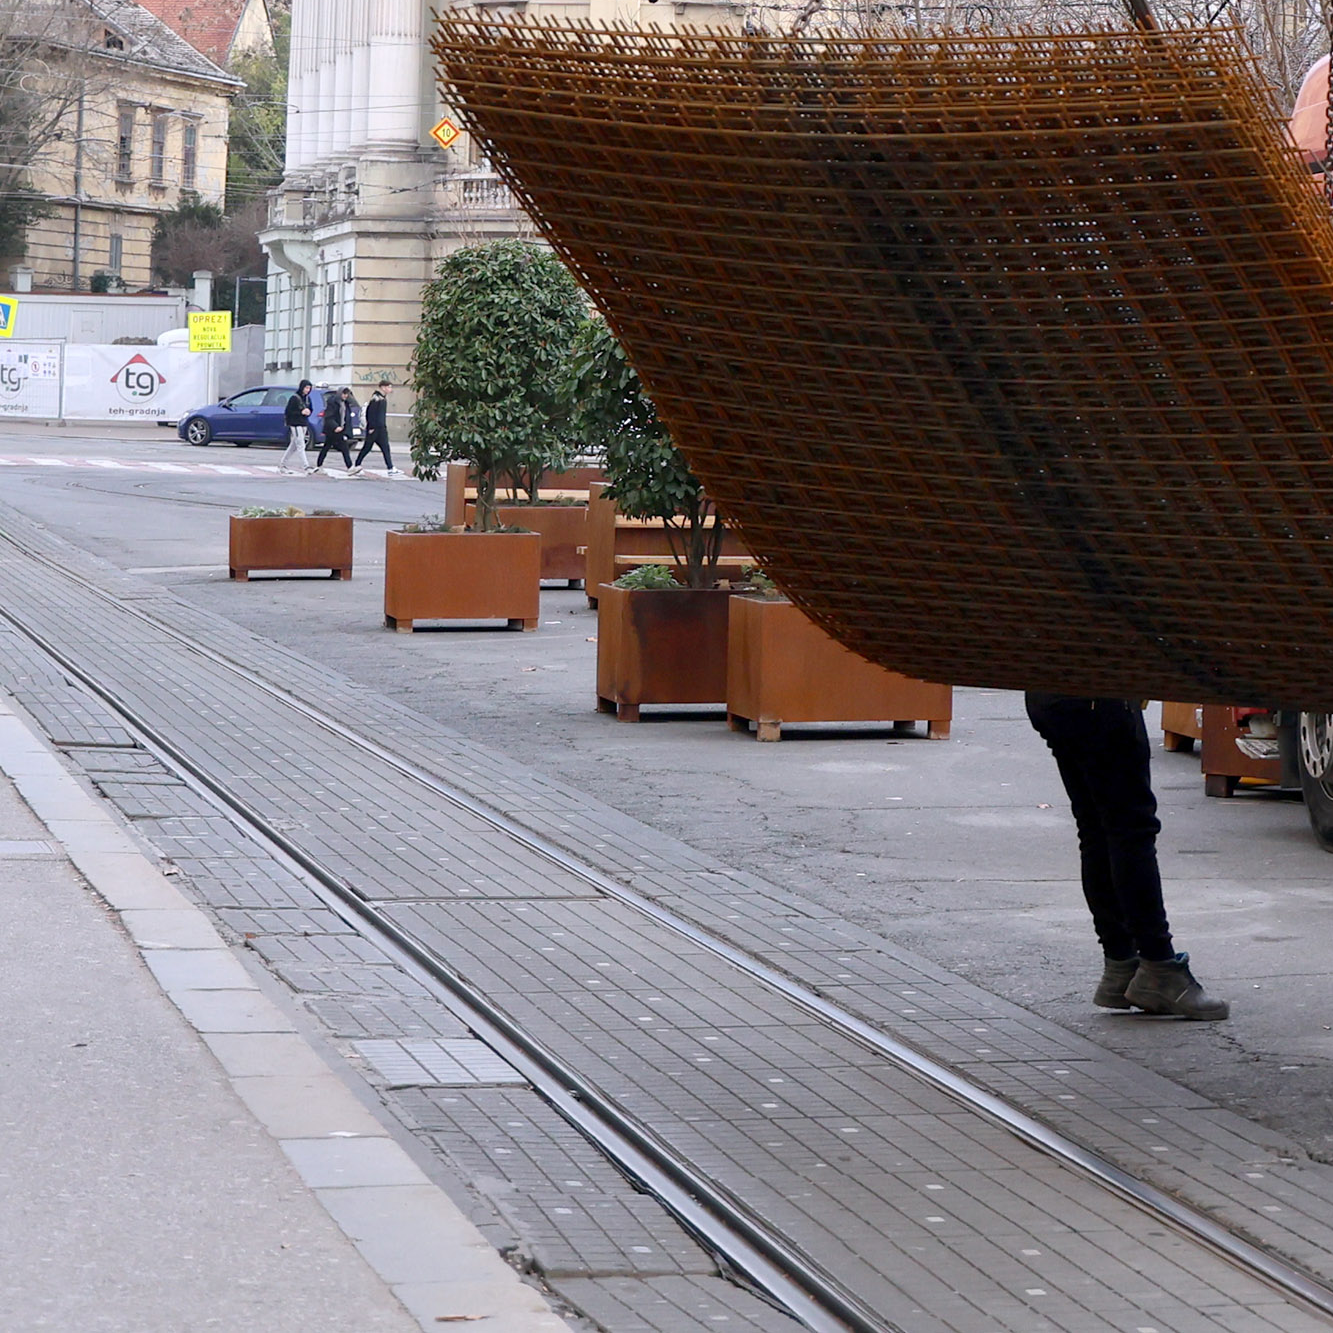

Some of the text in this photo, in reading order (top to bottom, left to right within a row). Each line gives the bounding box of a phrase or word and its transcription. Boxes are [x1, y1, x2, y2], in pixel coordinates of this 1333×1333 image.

[442, 128, 451, 138] 10
[193, 315, 227, 324] OPREZ!
[126, 368, 154, 396] tg
[109, 407, 166, 416] teh-gradnja
